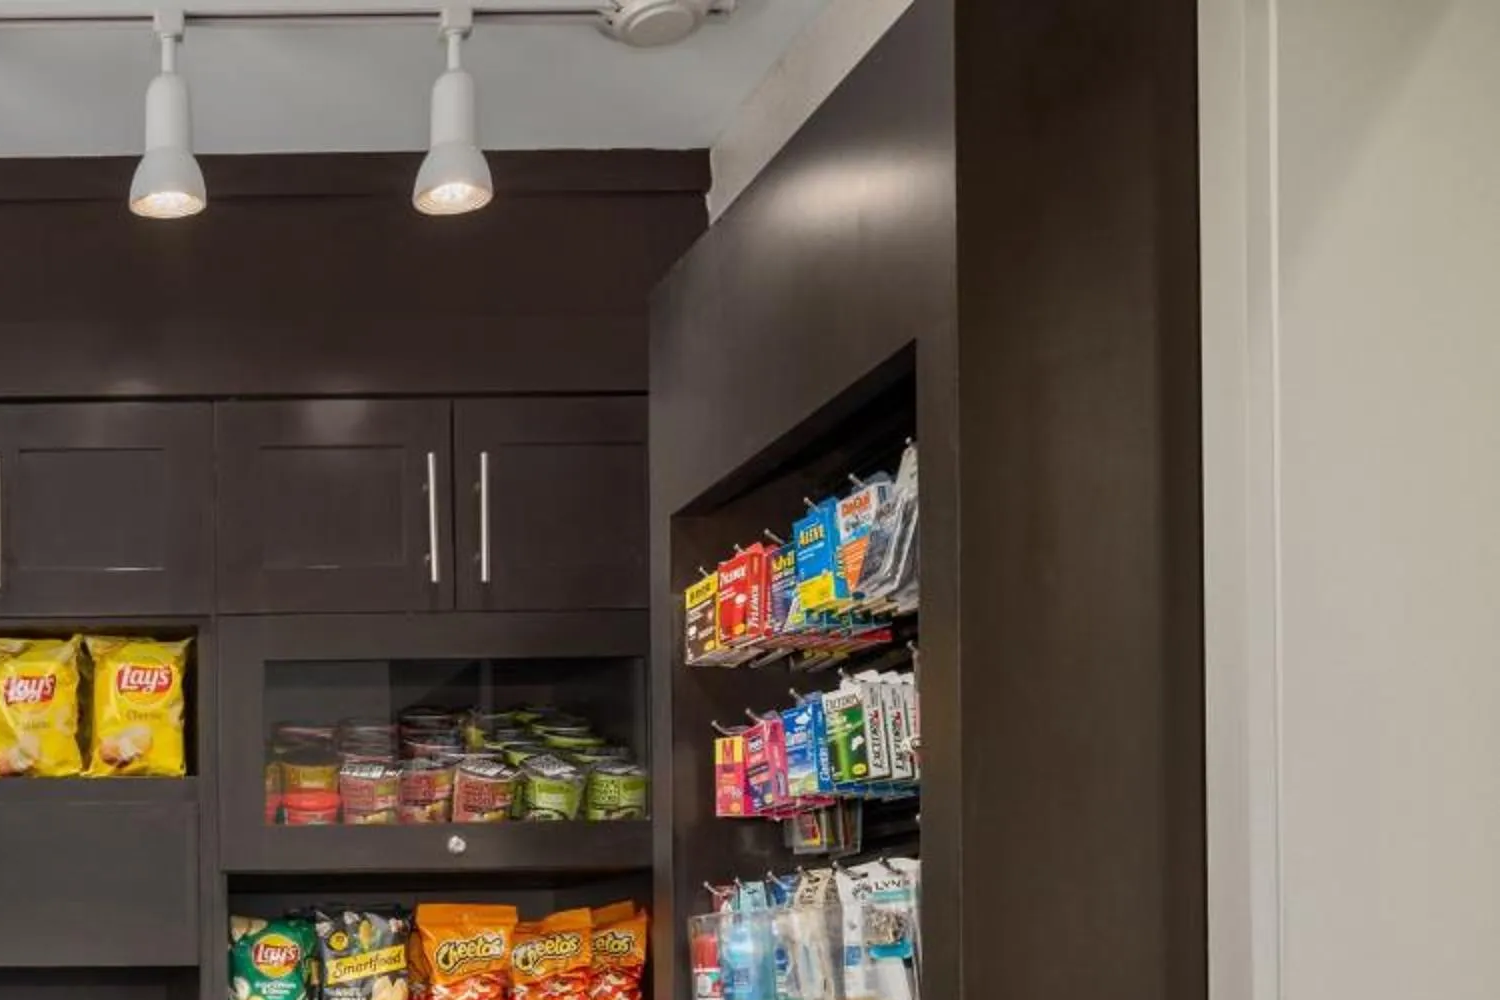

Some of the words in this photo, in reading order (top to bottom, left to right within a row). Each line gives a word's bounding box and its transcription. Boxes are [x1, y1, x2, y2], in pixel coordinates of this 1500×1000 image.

[120, 665, 171, 692] Lay's
[256, 943, 299, 965] Lay's
[333, 951, 402, 978] Smartfood
[435, 932, 504, 971] Cheetos
[511, 931, 581, 974] Cheetos
